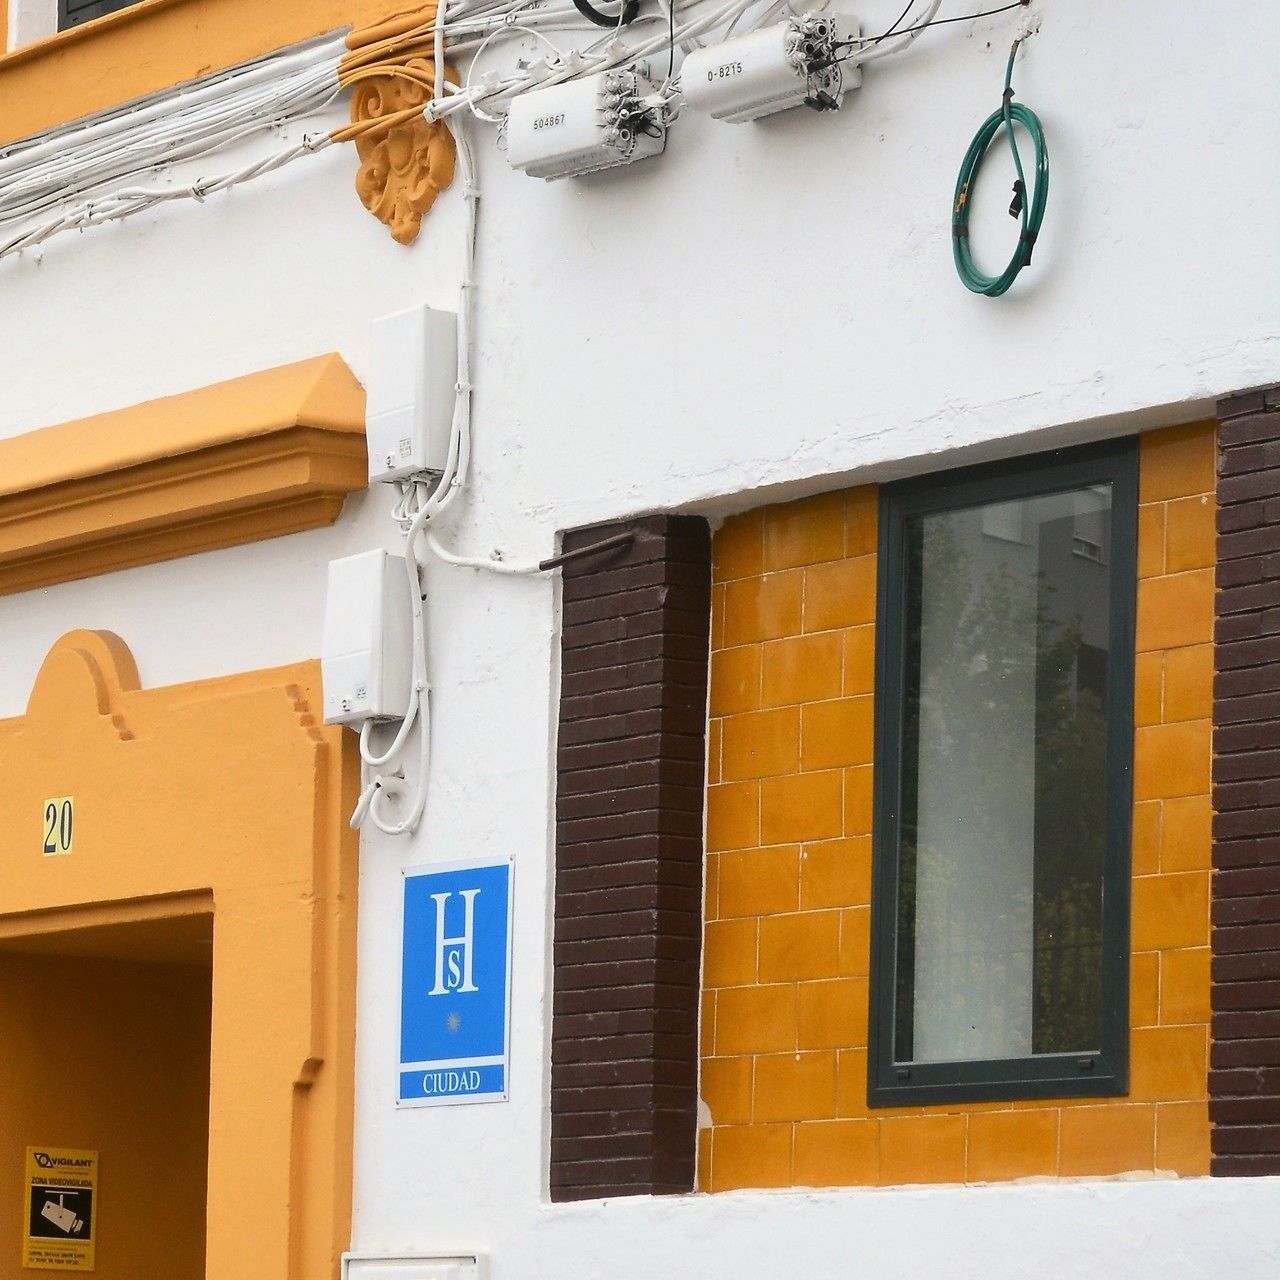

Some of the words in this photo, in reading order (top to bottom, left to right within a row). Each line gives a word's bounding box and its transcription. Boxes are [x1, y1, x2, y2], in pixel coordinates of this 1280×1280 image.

[533, 114, 565, 130] 504867
[43, 800, 72, 854] 20
[423, 1071, 480, 1093] CIUDAD
[52, 1157, 93, 1167] VIGILANT
